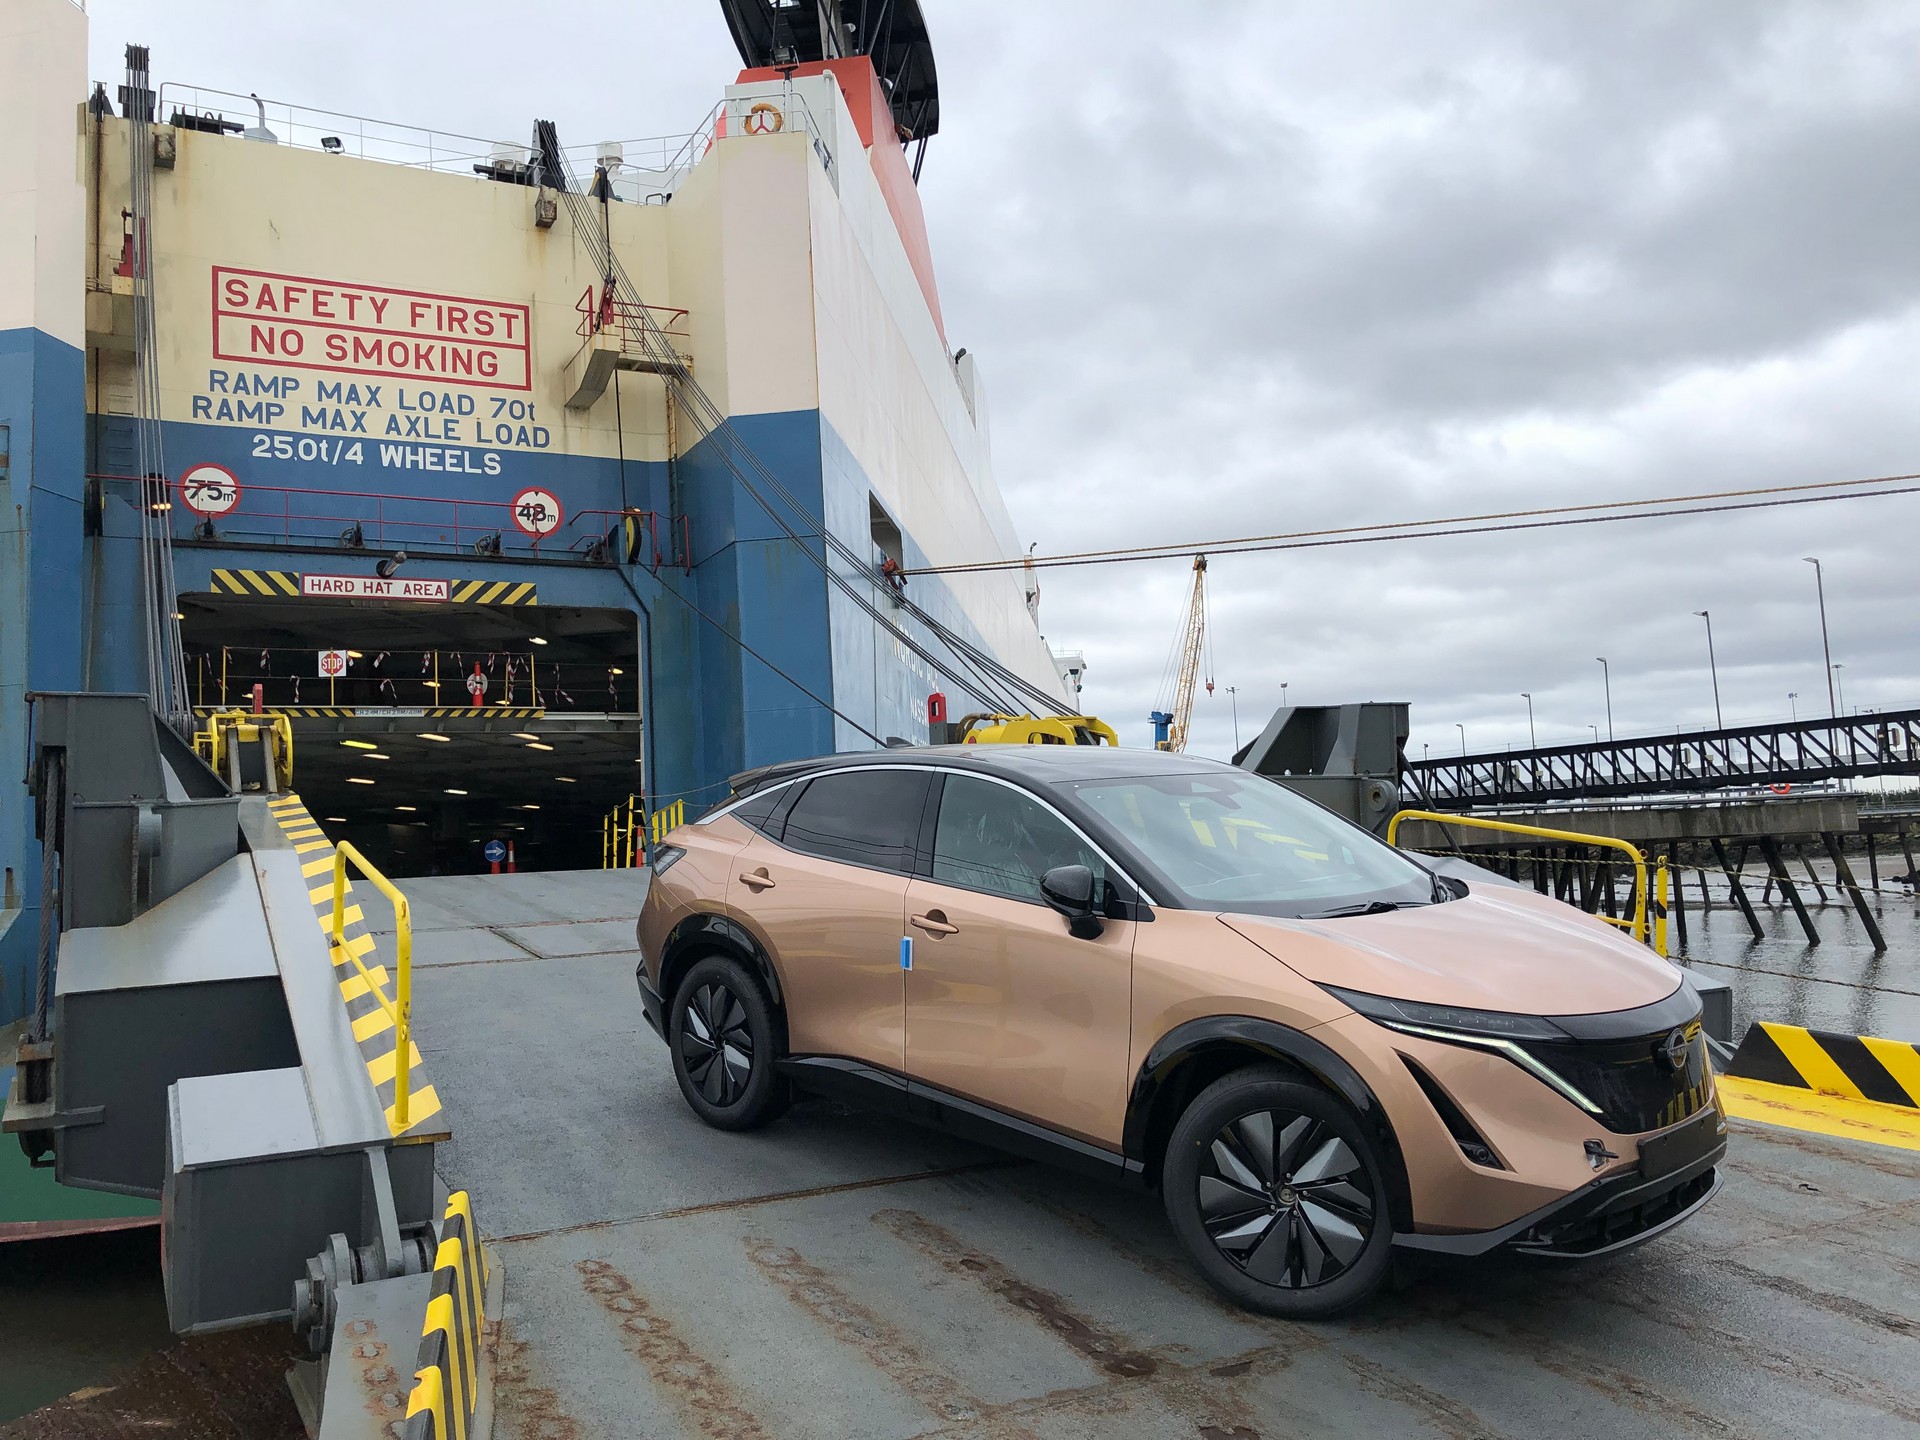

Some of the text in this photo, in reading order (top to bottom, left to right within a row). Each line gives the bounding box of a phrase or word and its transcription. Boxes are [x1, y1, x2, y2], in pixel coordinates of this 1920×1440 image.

[225, 279, 519, 339] SAFETY FIRST
[251, 324, 498, 377] NO SMOKING
[192, 395, 550, 448] RAMP MAX AXLE LOAD
[209, 369, 535, 422] RAMP MAX LOAD 70t
[379, 444, 501, 475] WHEELS
[311, 579, 444, 597] HARD HAT AREA
[322, 657, 343, 670] STOP
